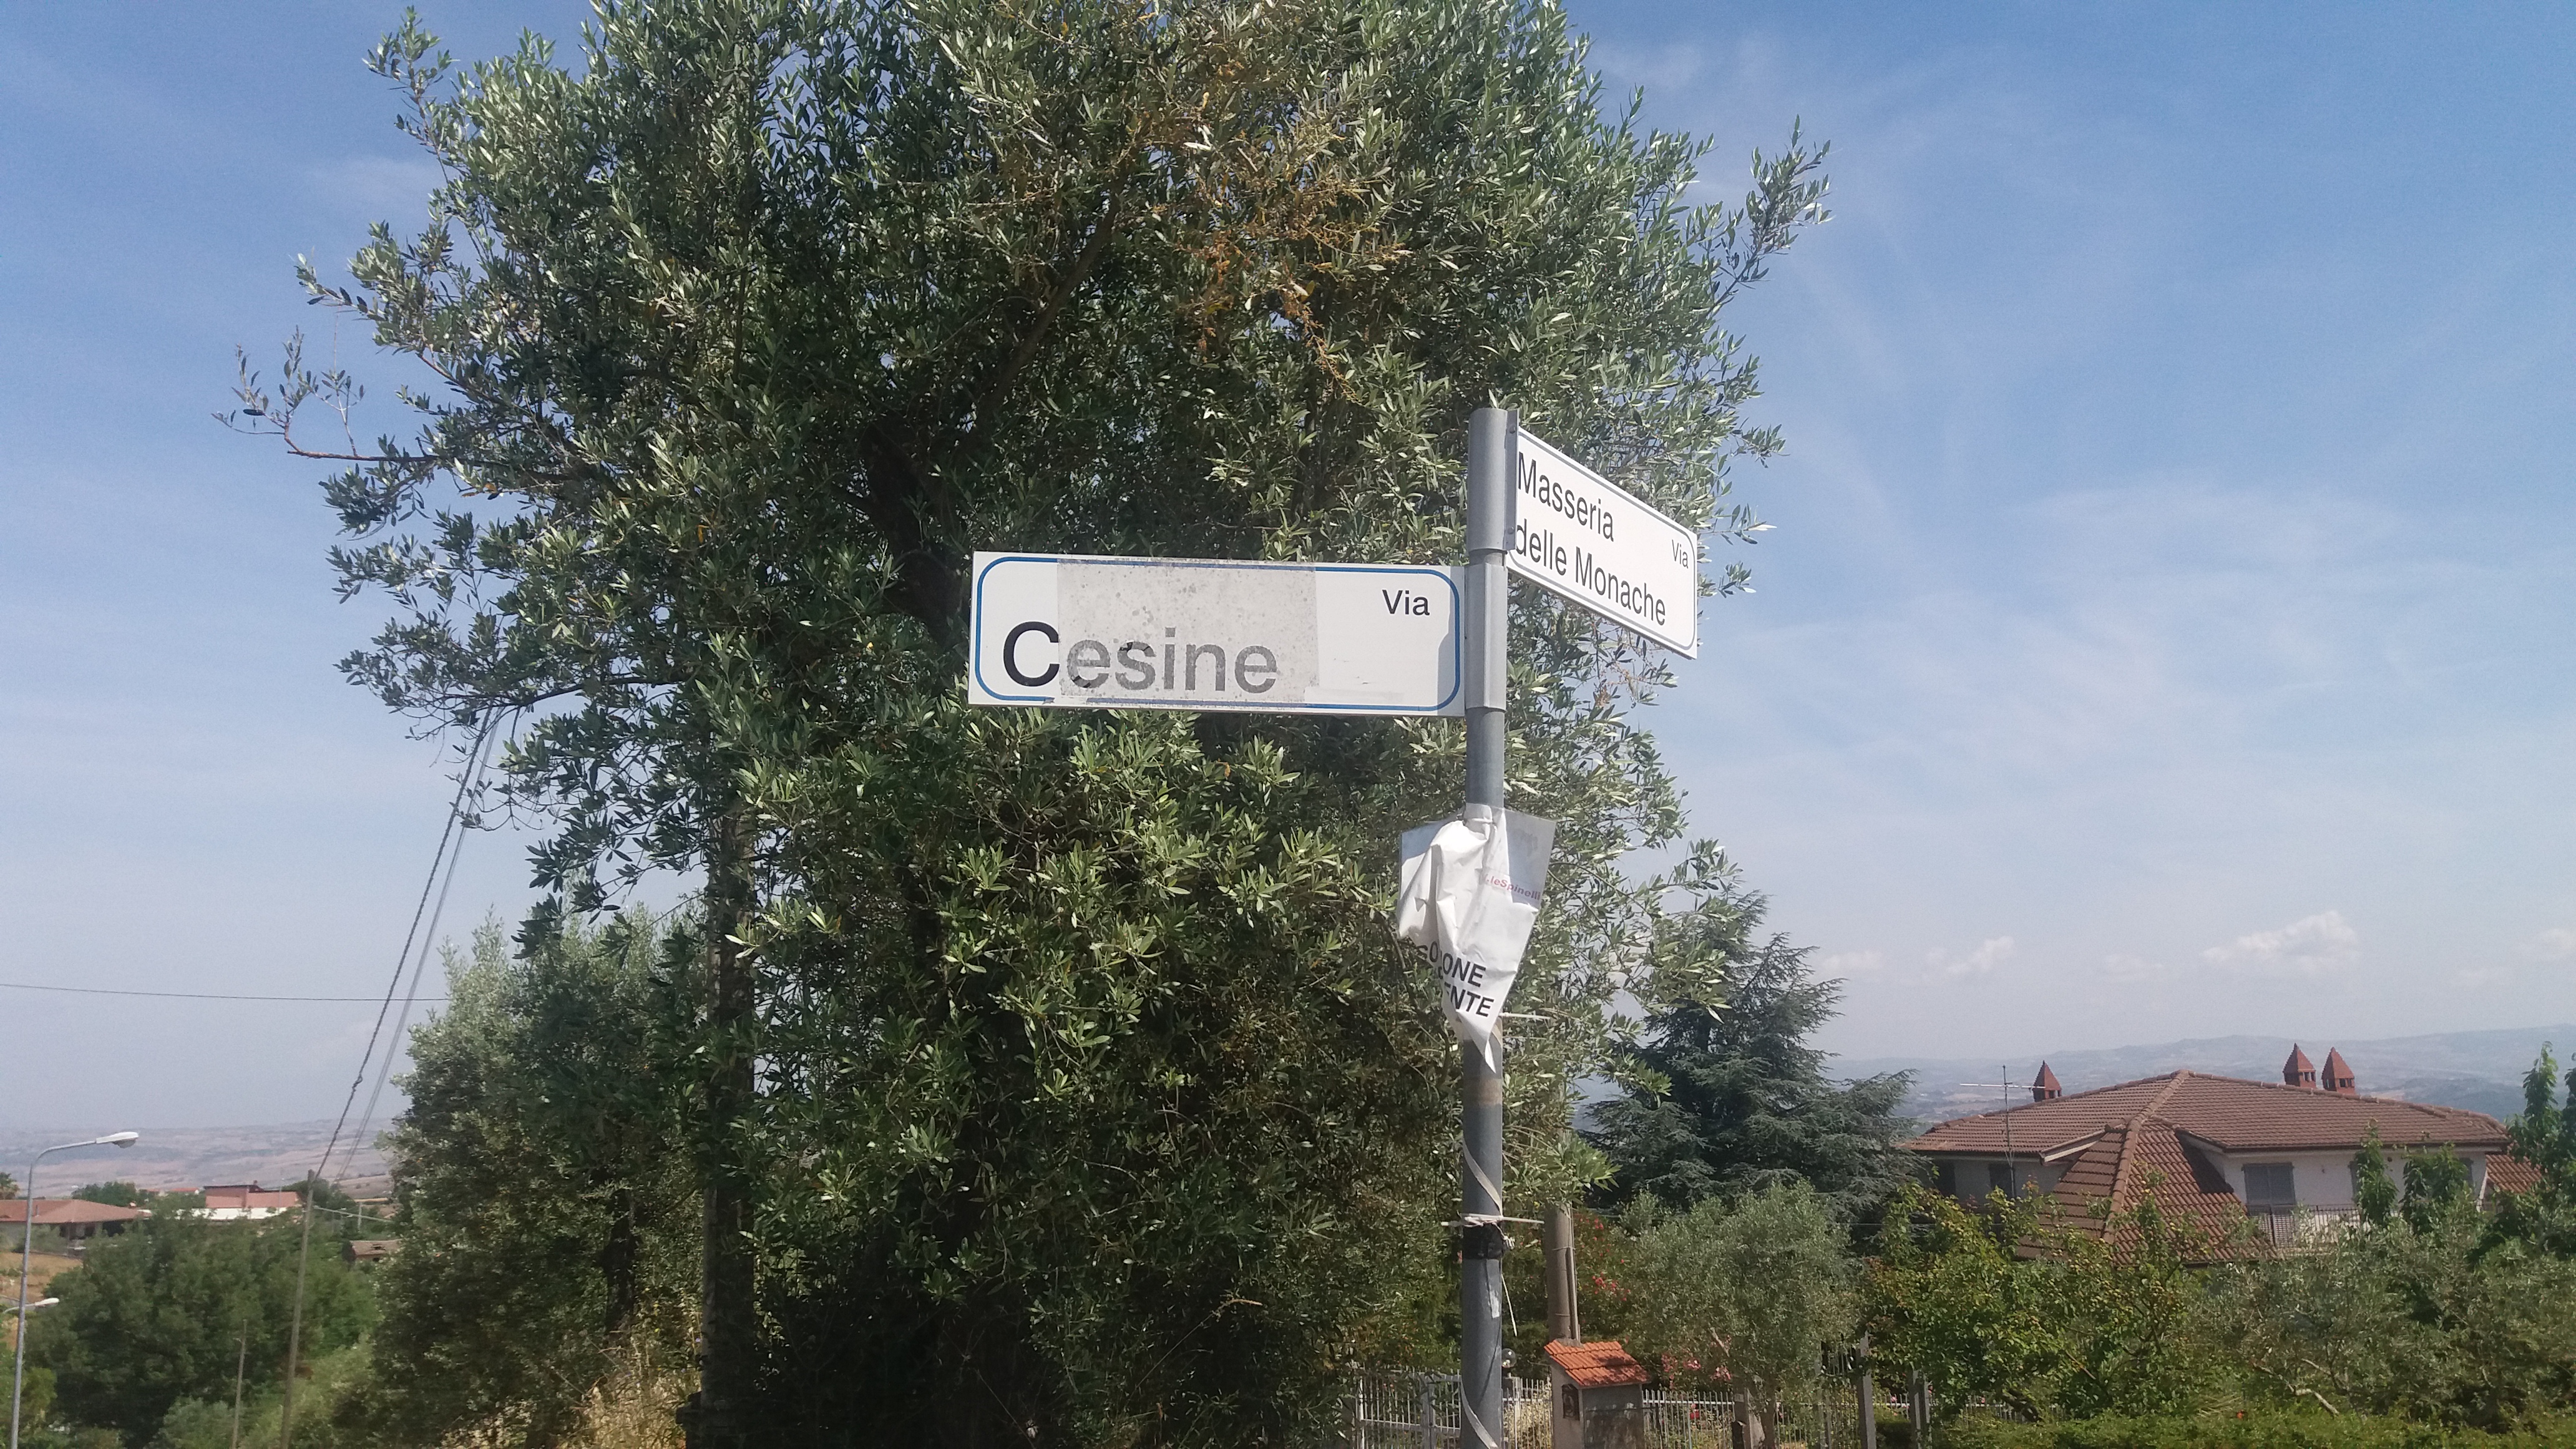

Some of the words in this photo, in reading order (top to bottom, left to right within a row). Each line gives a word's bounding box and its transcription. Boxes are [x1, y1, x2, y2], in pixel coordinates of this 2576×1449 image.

[1518, 451, 1614, 542] Masseria
[1516, 518, 1567, 576] delle
[1576, 546, 1666, 626] Monache
[1671, 539, 1689, 569] Via
[1382, 589, 1430, 616] Via
[1002, 621, 1278, 694] Cesine
